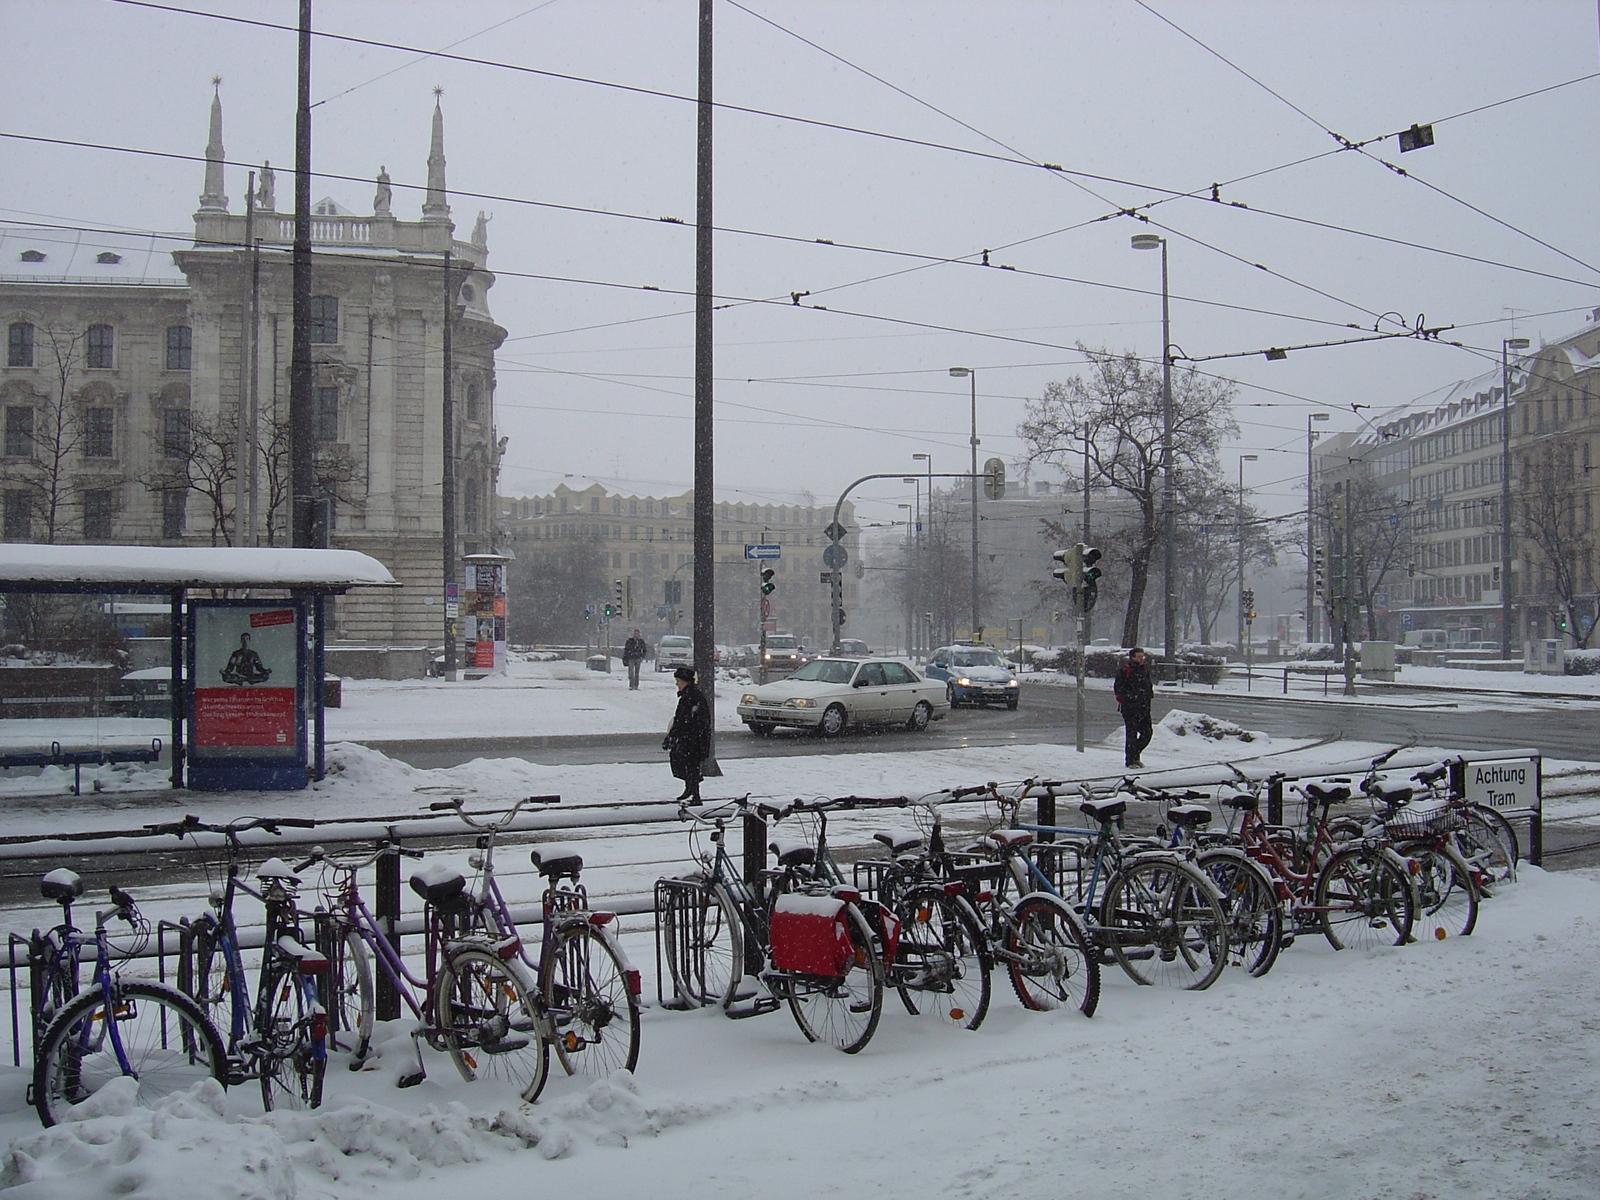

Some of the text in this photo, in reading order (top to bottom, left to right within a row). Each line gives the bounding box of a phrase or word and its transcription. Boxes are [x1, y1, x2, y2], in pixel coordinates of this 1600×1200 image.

[1402, 613, 1411, 625] P
[1475, 767, 1525, 785] Achtung
[1487, 790, 1516, 806] Tram
